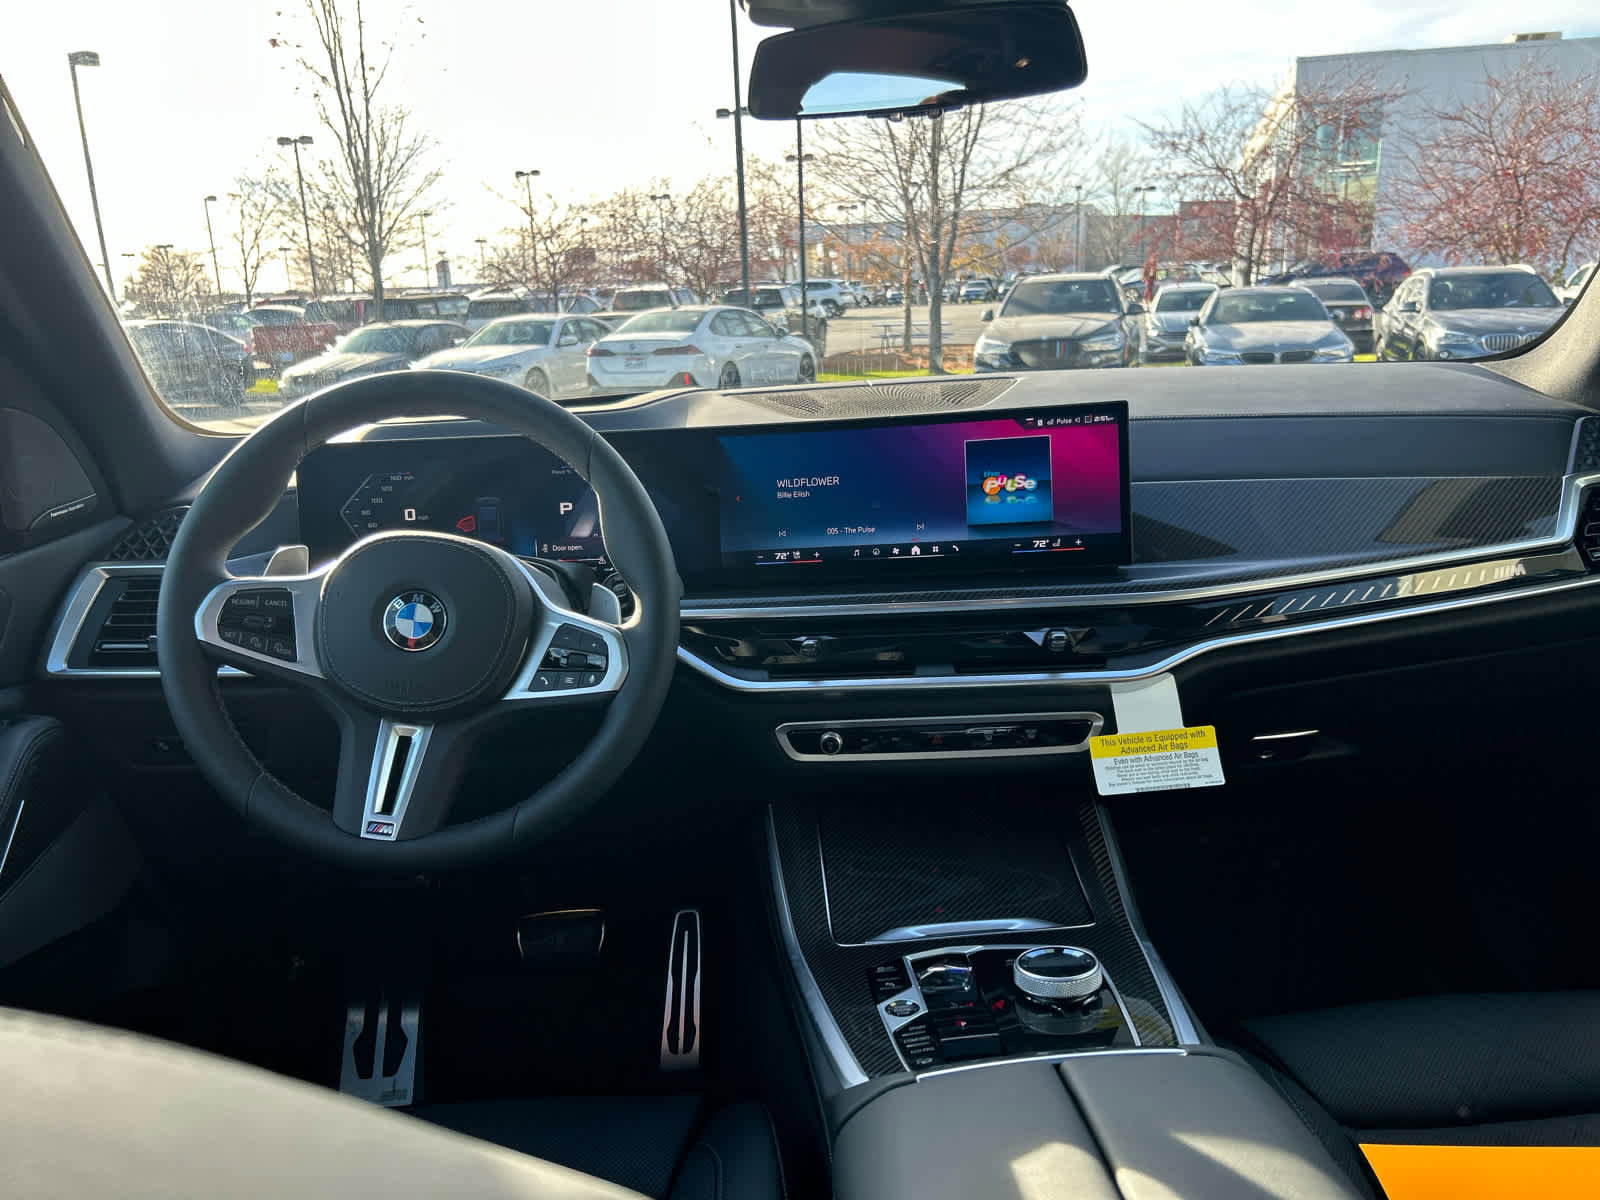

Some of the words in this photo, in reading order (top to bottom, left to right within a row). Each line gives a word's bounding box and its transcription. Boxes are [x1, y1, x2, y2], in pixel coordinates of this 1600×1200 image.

[776, 476, 840, 488] WILDFLOWER
[404, 508, 417, 521] 0
[559, 502, 573, 515] P
[826, 527, 839, 535] 005
[857, 526, 877, 535] Pulse
[393, 593, 442, 614] BMW
[1101, 738, 1117, 747] This
[1118, 735, 1144, 746] Vehicle
[1146, 735, 1153, 744] is
[1154, 731, 1188, 743] Equipped
[1189, 729, 1206, 739] with
[1120, 743, 1156, 754] Advanced
[1158, 742, 1169, 751] Air
[1170, 741, 1189, 752] Bags
[1113, 758, 1129, 766] Even
[1129, 756, 1143, 764] with
[1143, 753, 1174, 763] Advanced
[1174, 752, 1184, 760] Air
[1184, 750, 1199, 760] Bags
